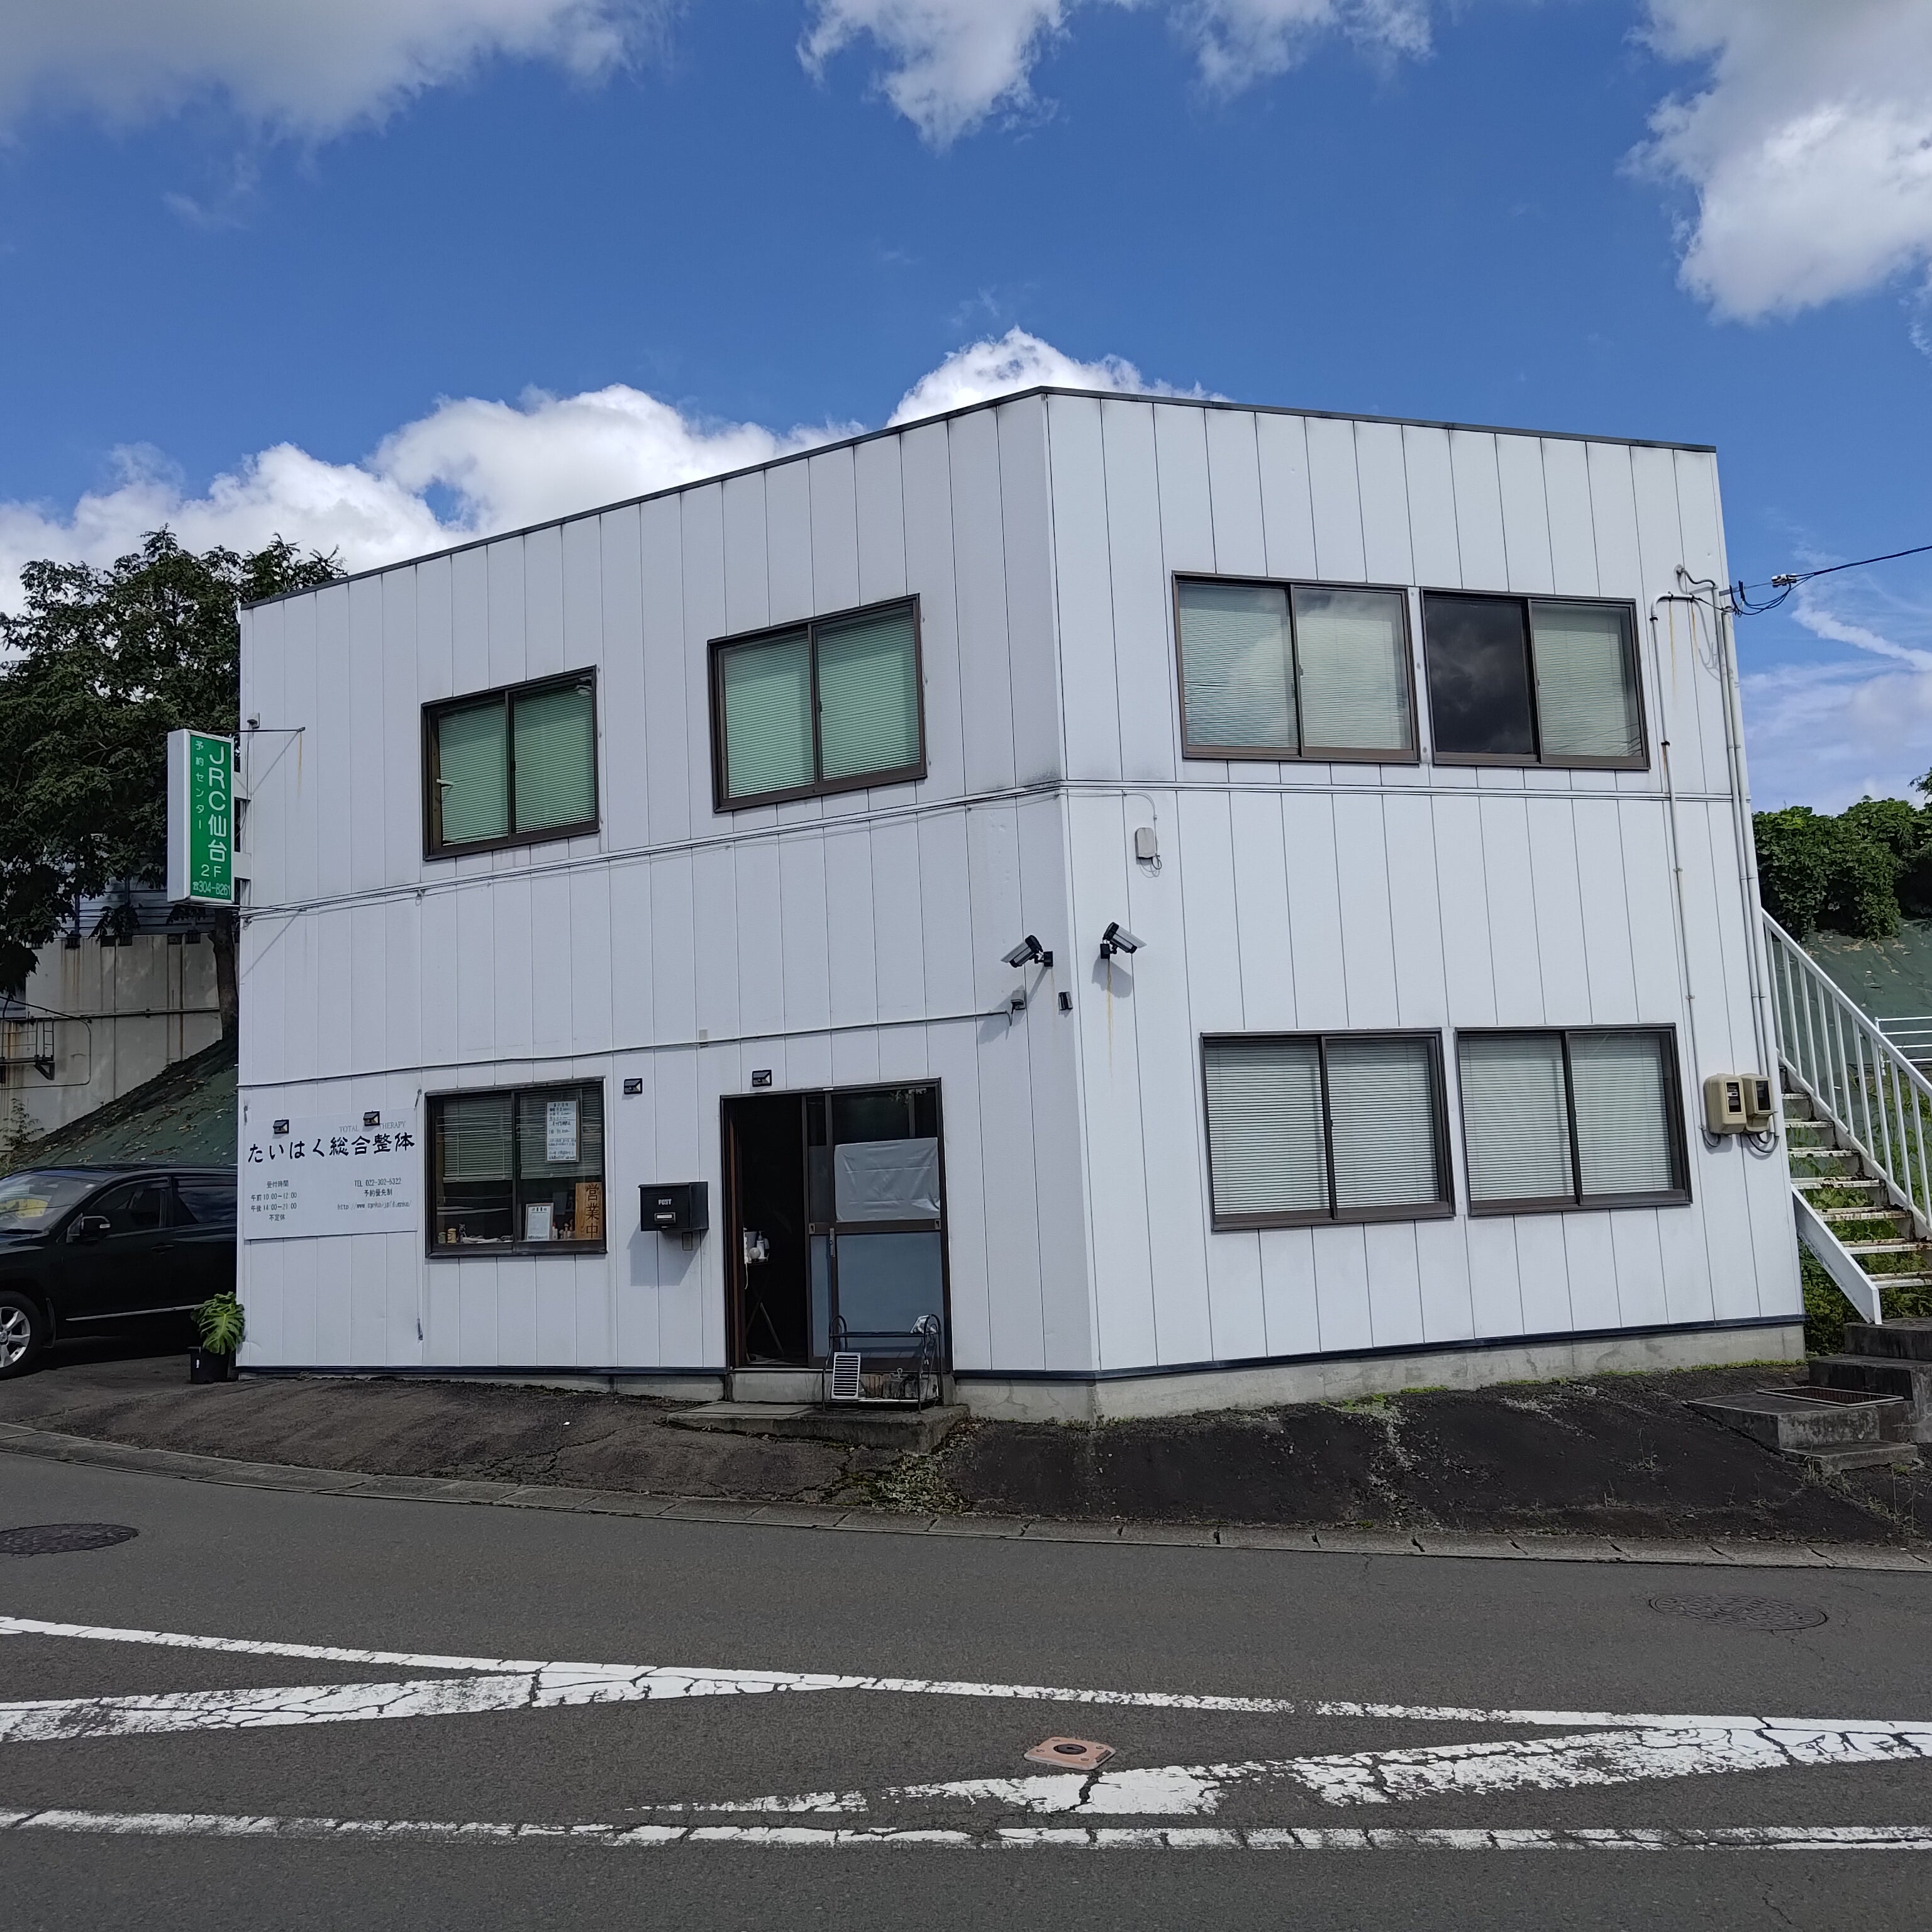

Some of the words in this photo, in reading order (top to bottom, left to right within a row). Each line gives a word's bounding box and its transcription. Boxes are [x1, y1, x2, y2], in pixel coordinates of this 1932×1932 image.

[196, 740, 204, 830] 予約センター
[208, 746, 227, 862] JRC仙台
[338, 1124, 359, 1133] TOTAL
[379, 1121, 406, 1130] THERAPY
[248, 1132, 415, 1163] たいはく総合整体
[267, 1180, 289, 1189] 受付時間
[364, 1188, 392, 1197] 予約優先制
[586, 1184, 599, 1238] 営業中
